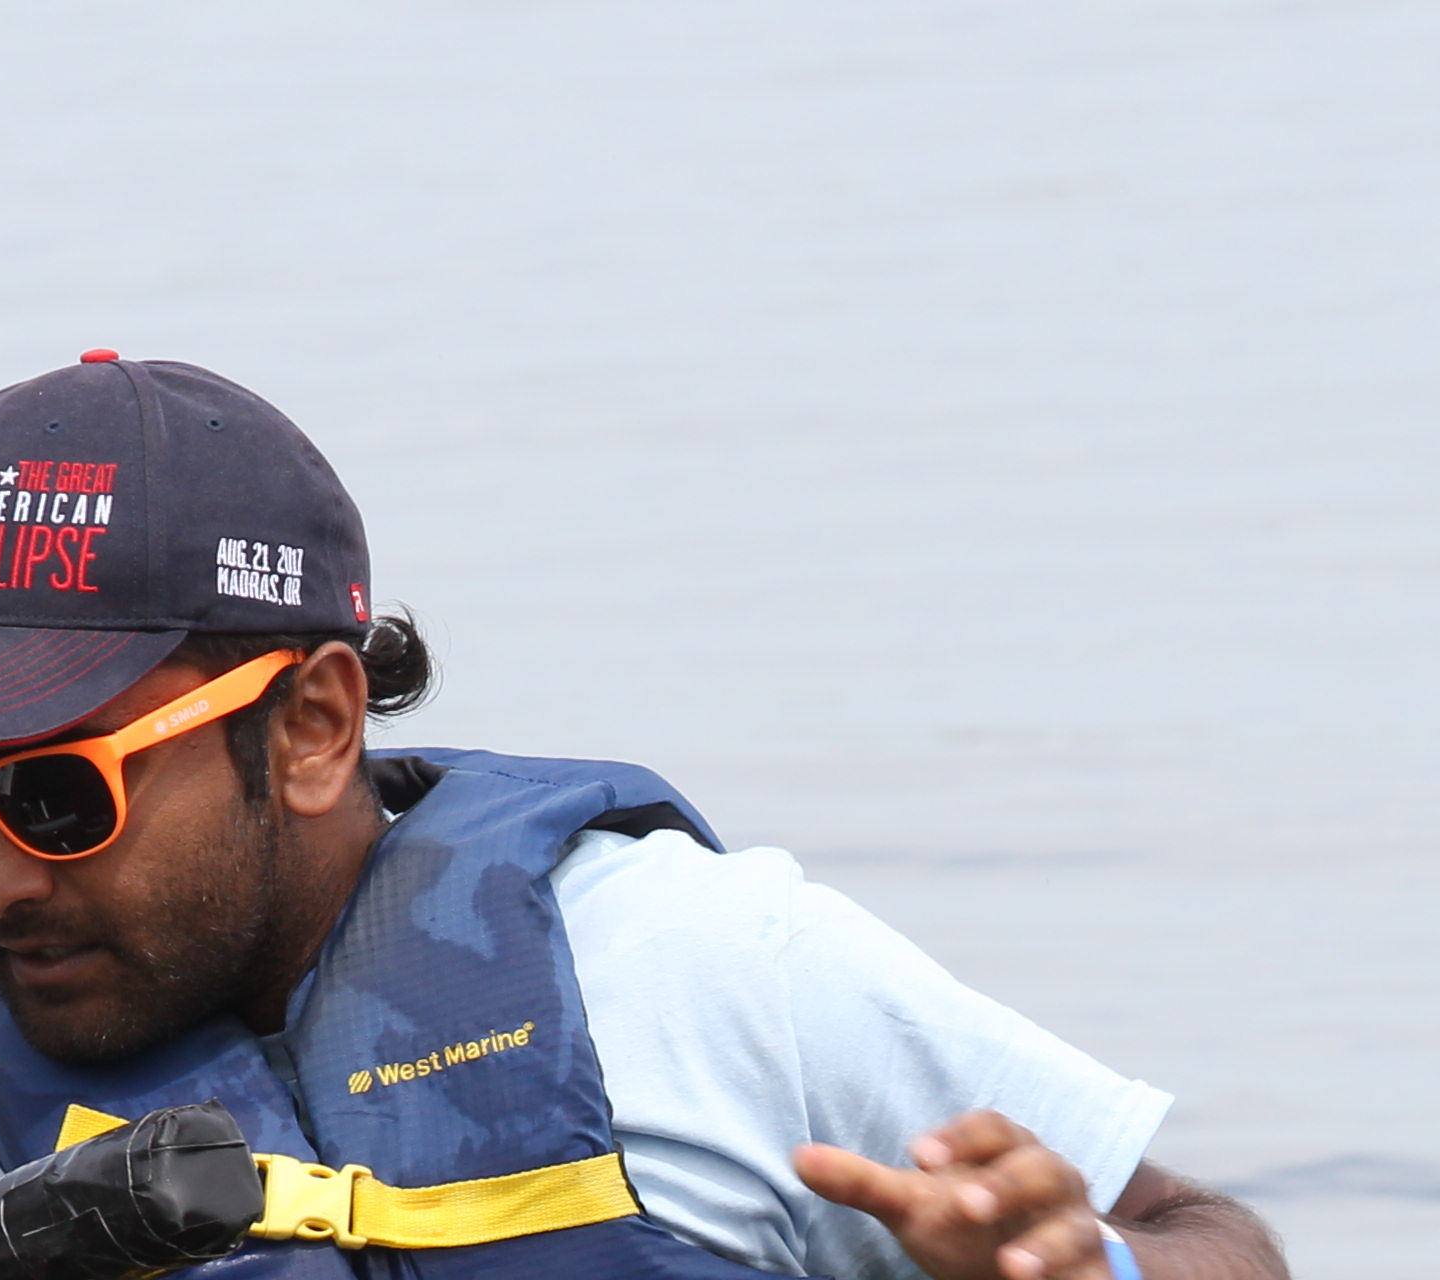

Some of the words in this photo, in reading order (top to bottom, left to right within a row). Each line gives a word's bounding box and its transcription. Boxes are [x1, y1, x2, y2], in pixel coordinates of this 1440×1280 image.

[17, 460, 55, 492] THE
[55, 462, 118, 494] GREAT
[216, 537, 252, 570] AUG.
[252, 541, 271, 572] 21
[277, 544, 304, 576] 2017
[283, 576, 302, 606] OR
[168, 699, 209, 728] SMUD
[376, 1051, 443, 1087] West
